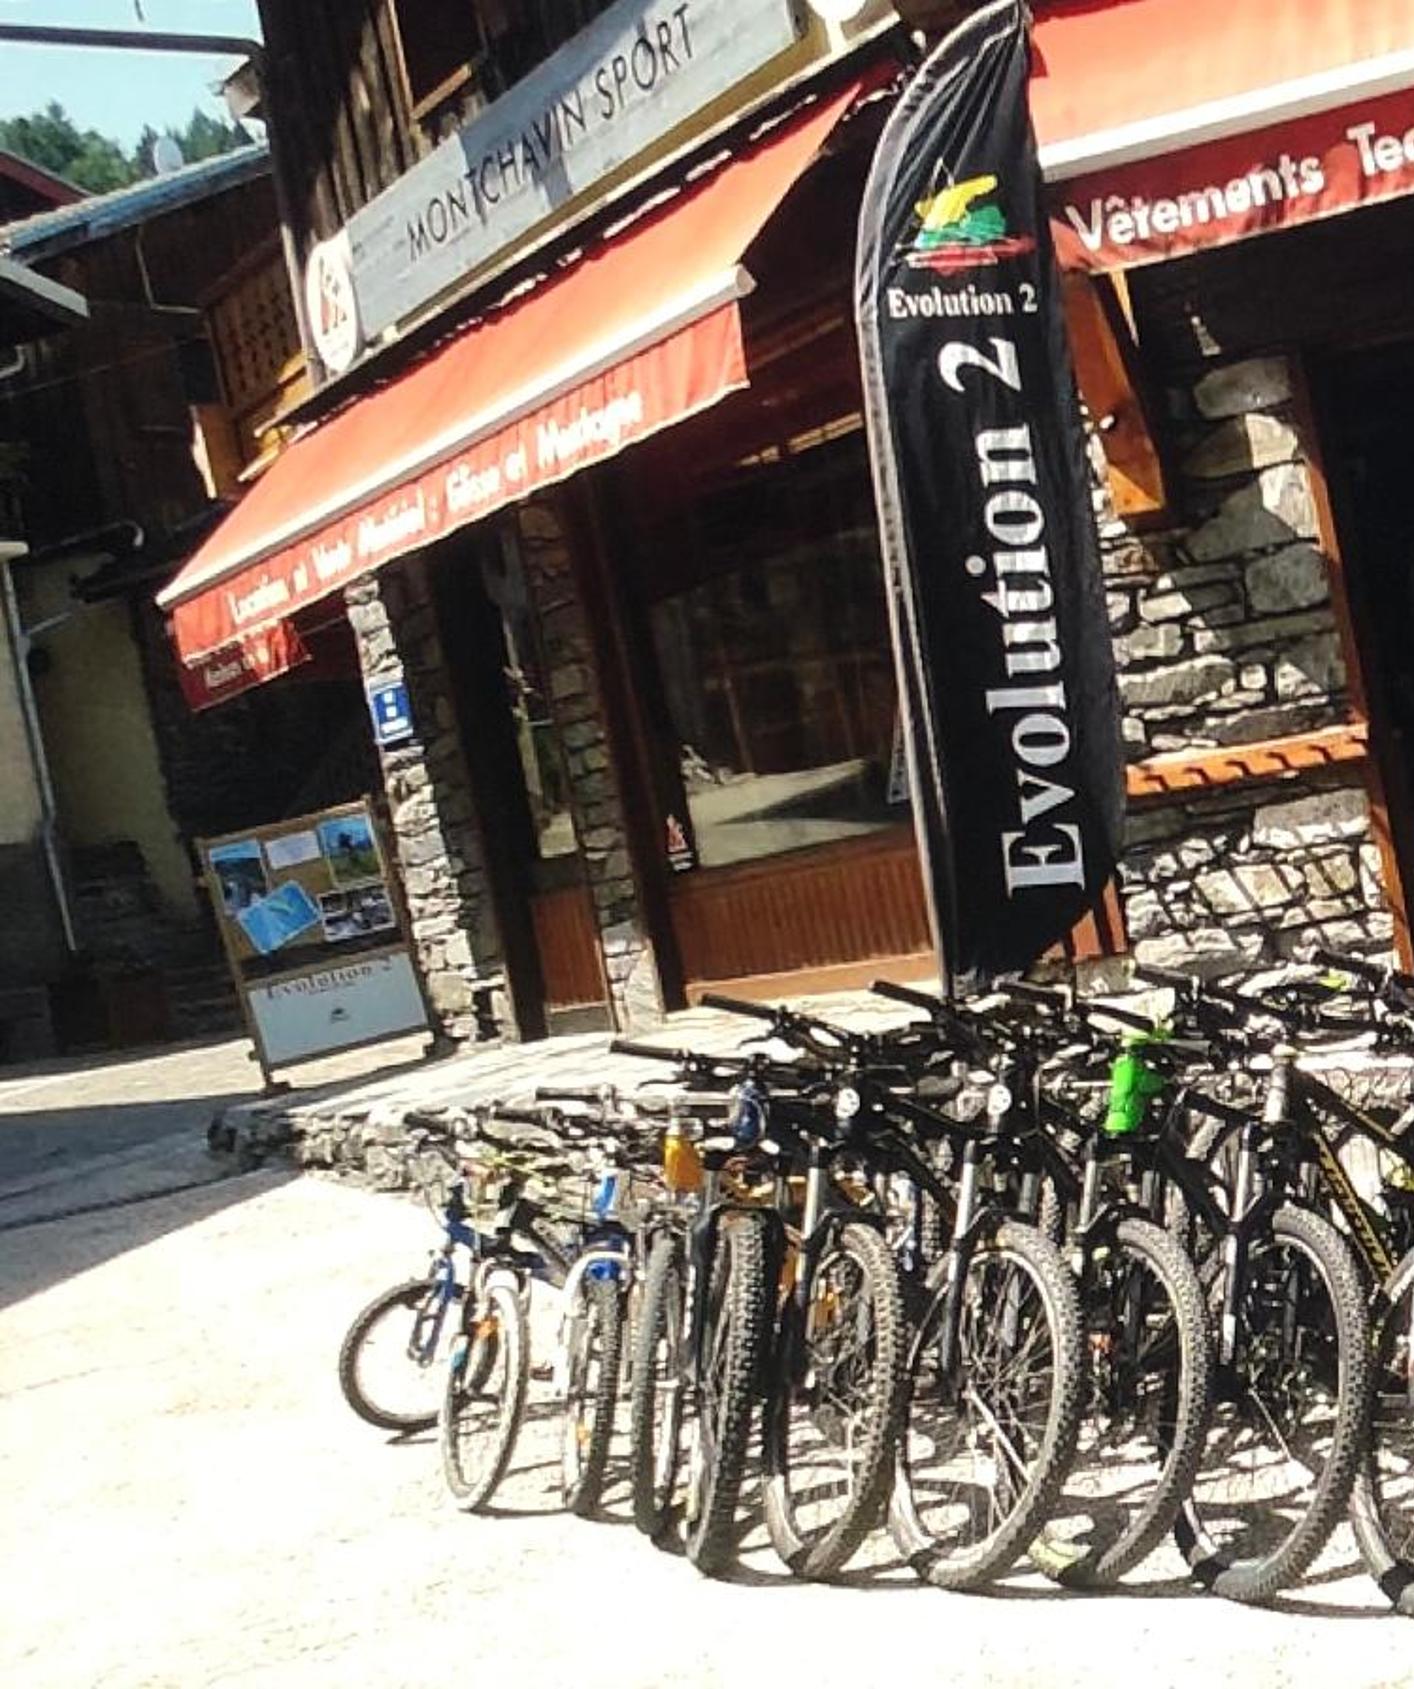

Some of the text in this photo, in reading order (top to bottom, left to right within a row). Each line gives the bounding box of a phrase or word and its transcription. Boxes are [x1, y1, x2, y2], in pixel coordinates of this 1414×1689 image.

[406, 3, 695, 261] MONTCHAVIN SPORT
[1066, 153, 1325, 251] Vêtements
[886, 282, 1039, 318] Evolution 2
[937, 336, 1087, 898] Evolution 2
